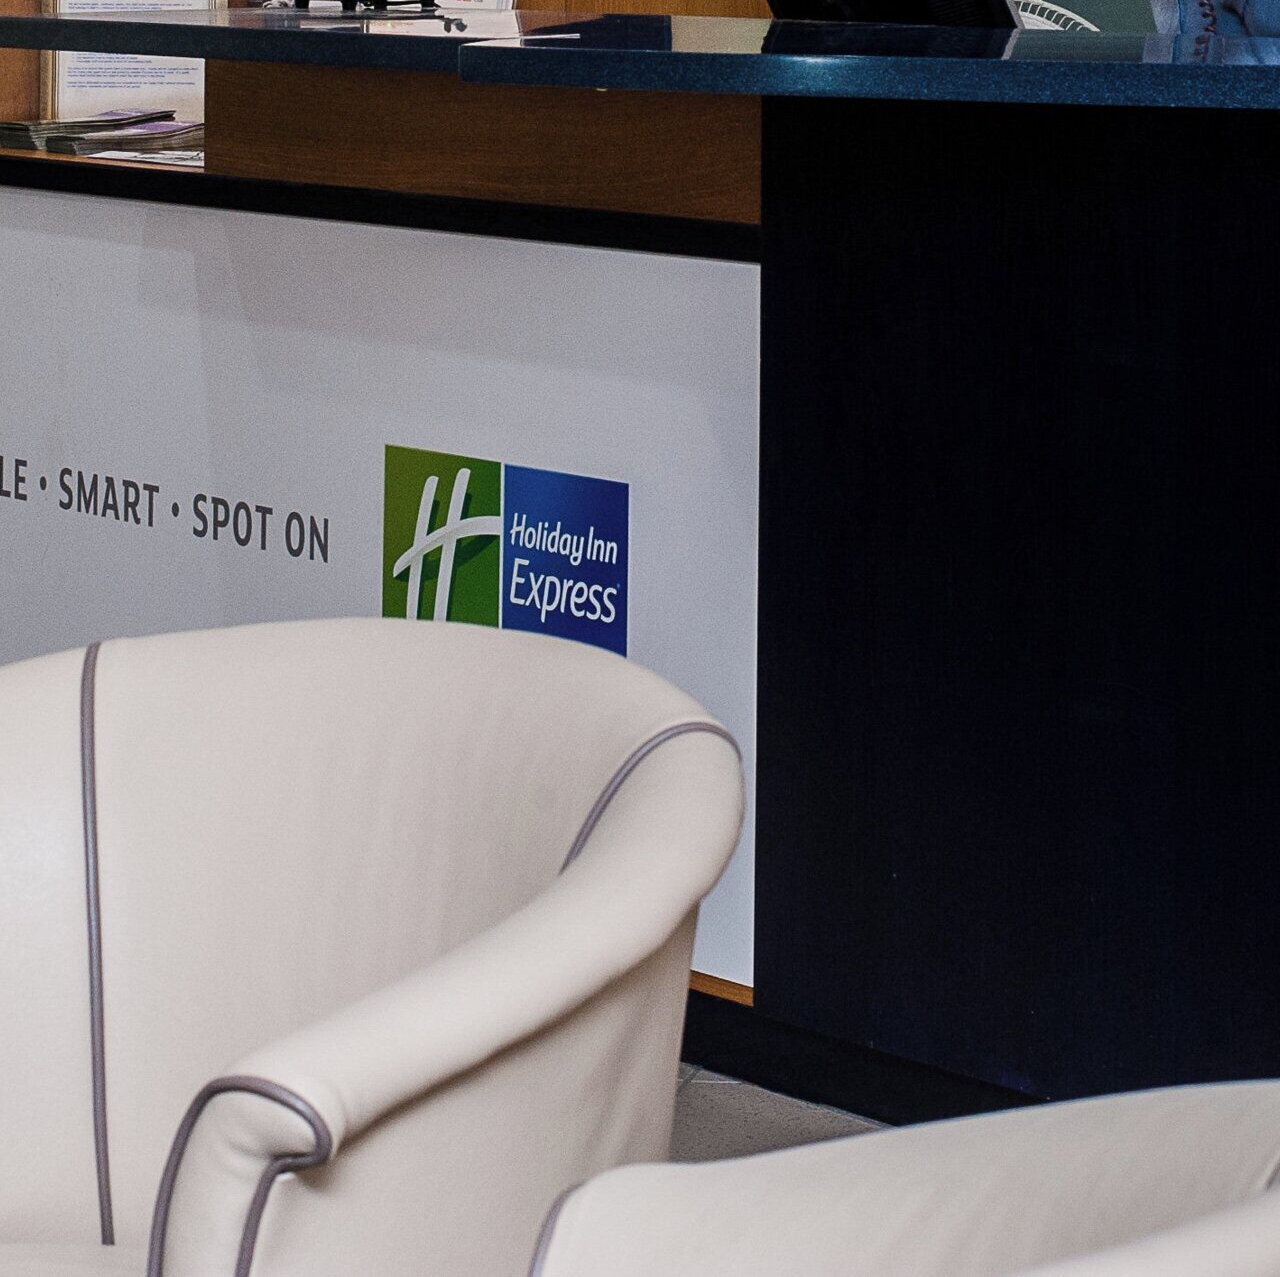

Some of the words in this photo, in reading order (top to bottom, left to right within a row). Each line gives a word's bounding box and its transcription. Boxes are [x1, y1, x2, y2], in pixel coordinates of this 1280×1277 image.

[58, 467, 160, 528] SMART
[192, 493, 273, 551] SPOT
[285, 511, 330, 564] ON
[509, 512, 585, 566] Holiday
[586, 526, 618, 565] Inn
[509, 557, 618, 624] Express
